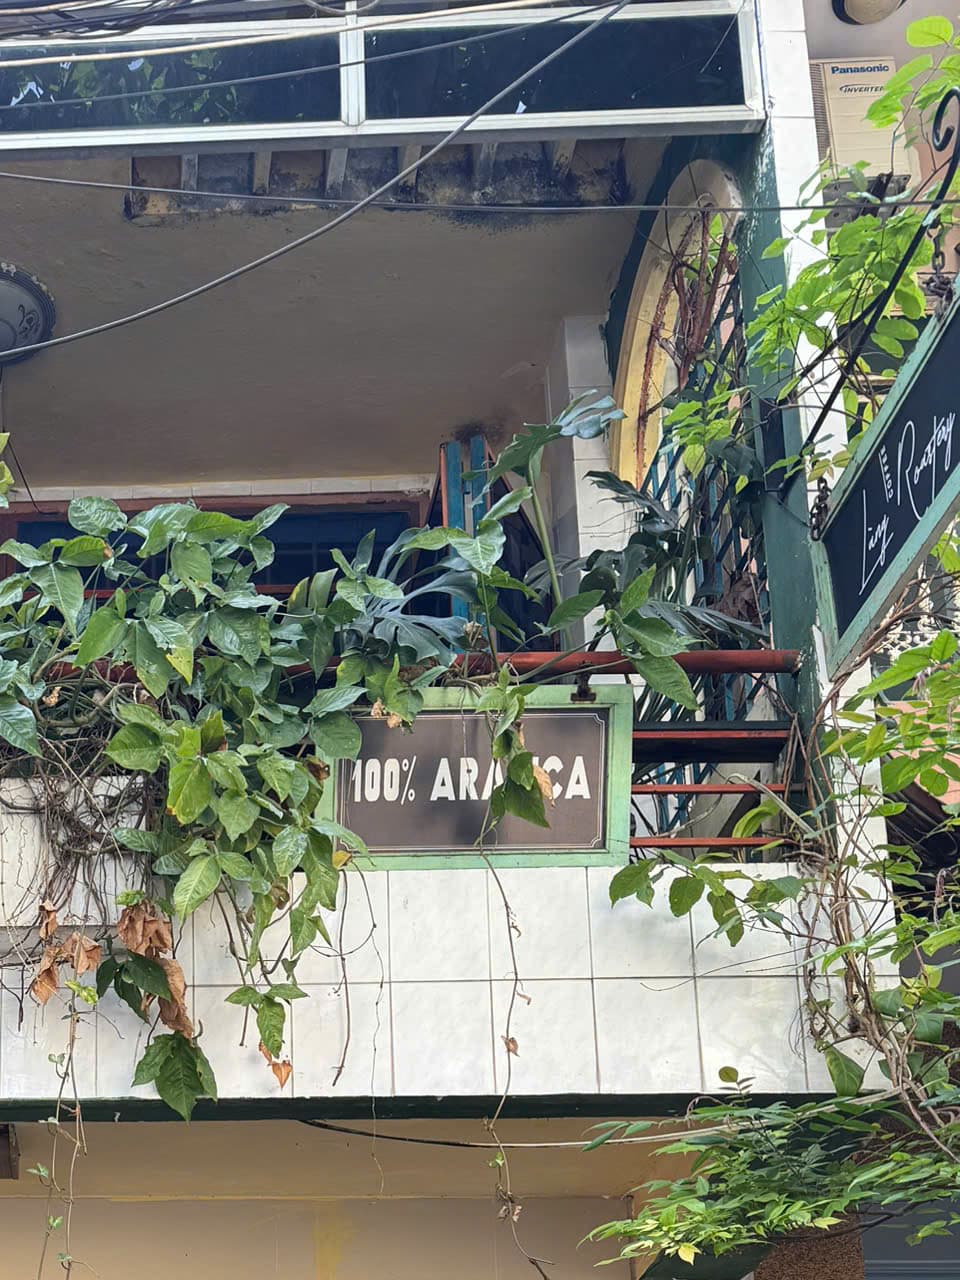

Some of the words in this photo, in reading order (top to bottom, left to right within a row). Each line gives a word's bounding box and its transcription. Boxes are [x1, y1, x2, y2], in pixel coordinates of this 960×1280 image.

[831, 64, 889, 74] Panasonic
[898, 412, 956, 521] Roastery
[351, 755, 417, 805] 100%
[430, 754, 591, 801] ARACA
